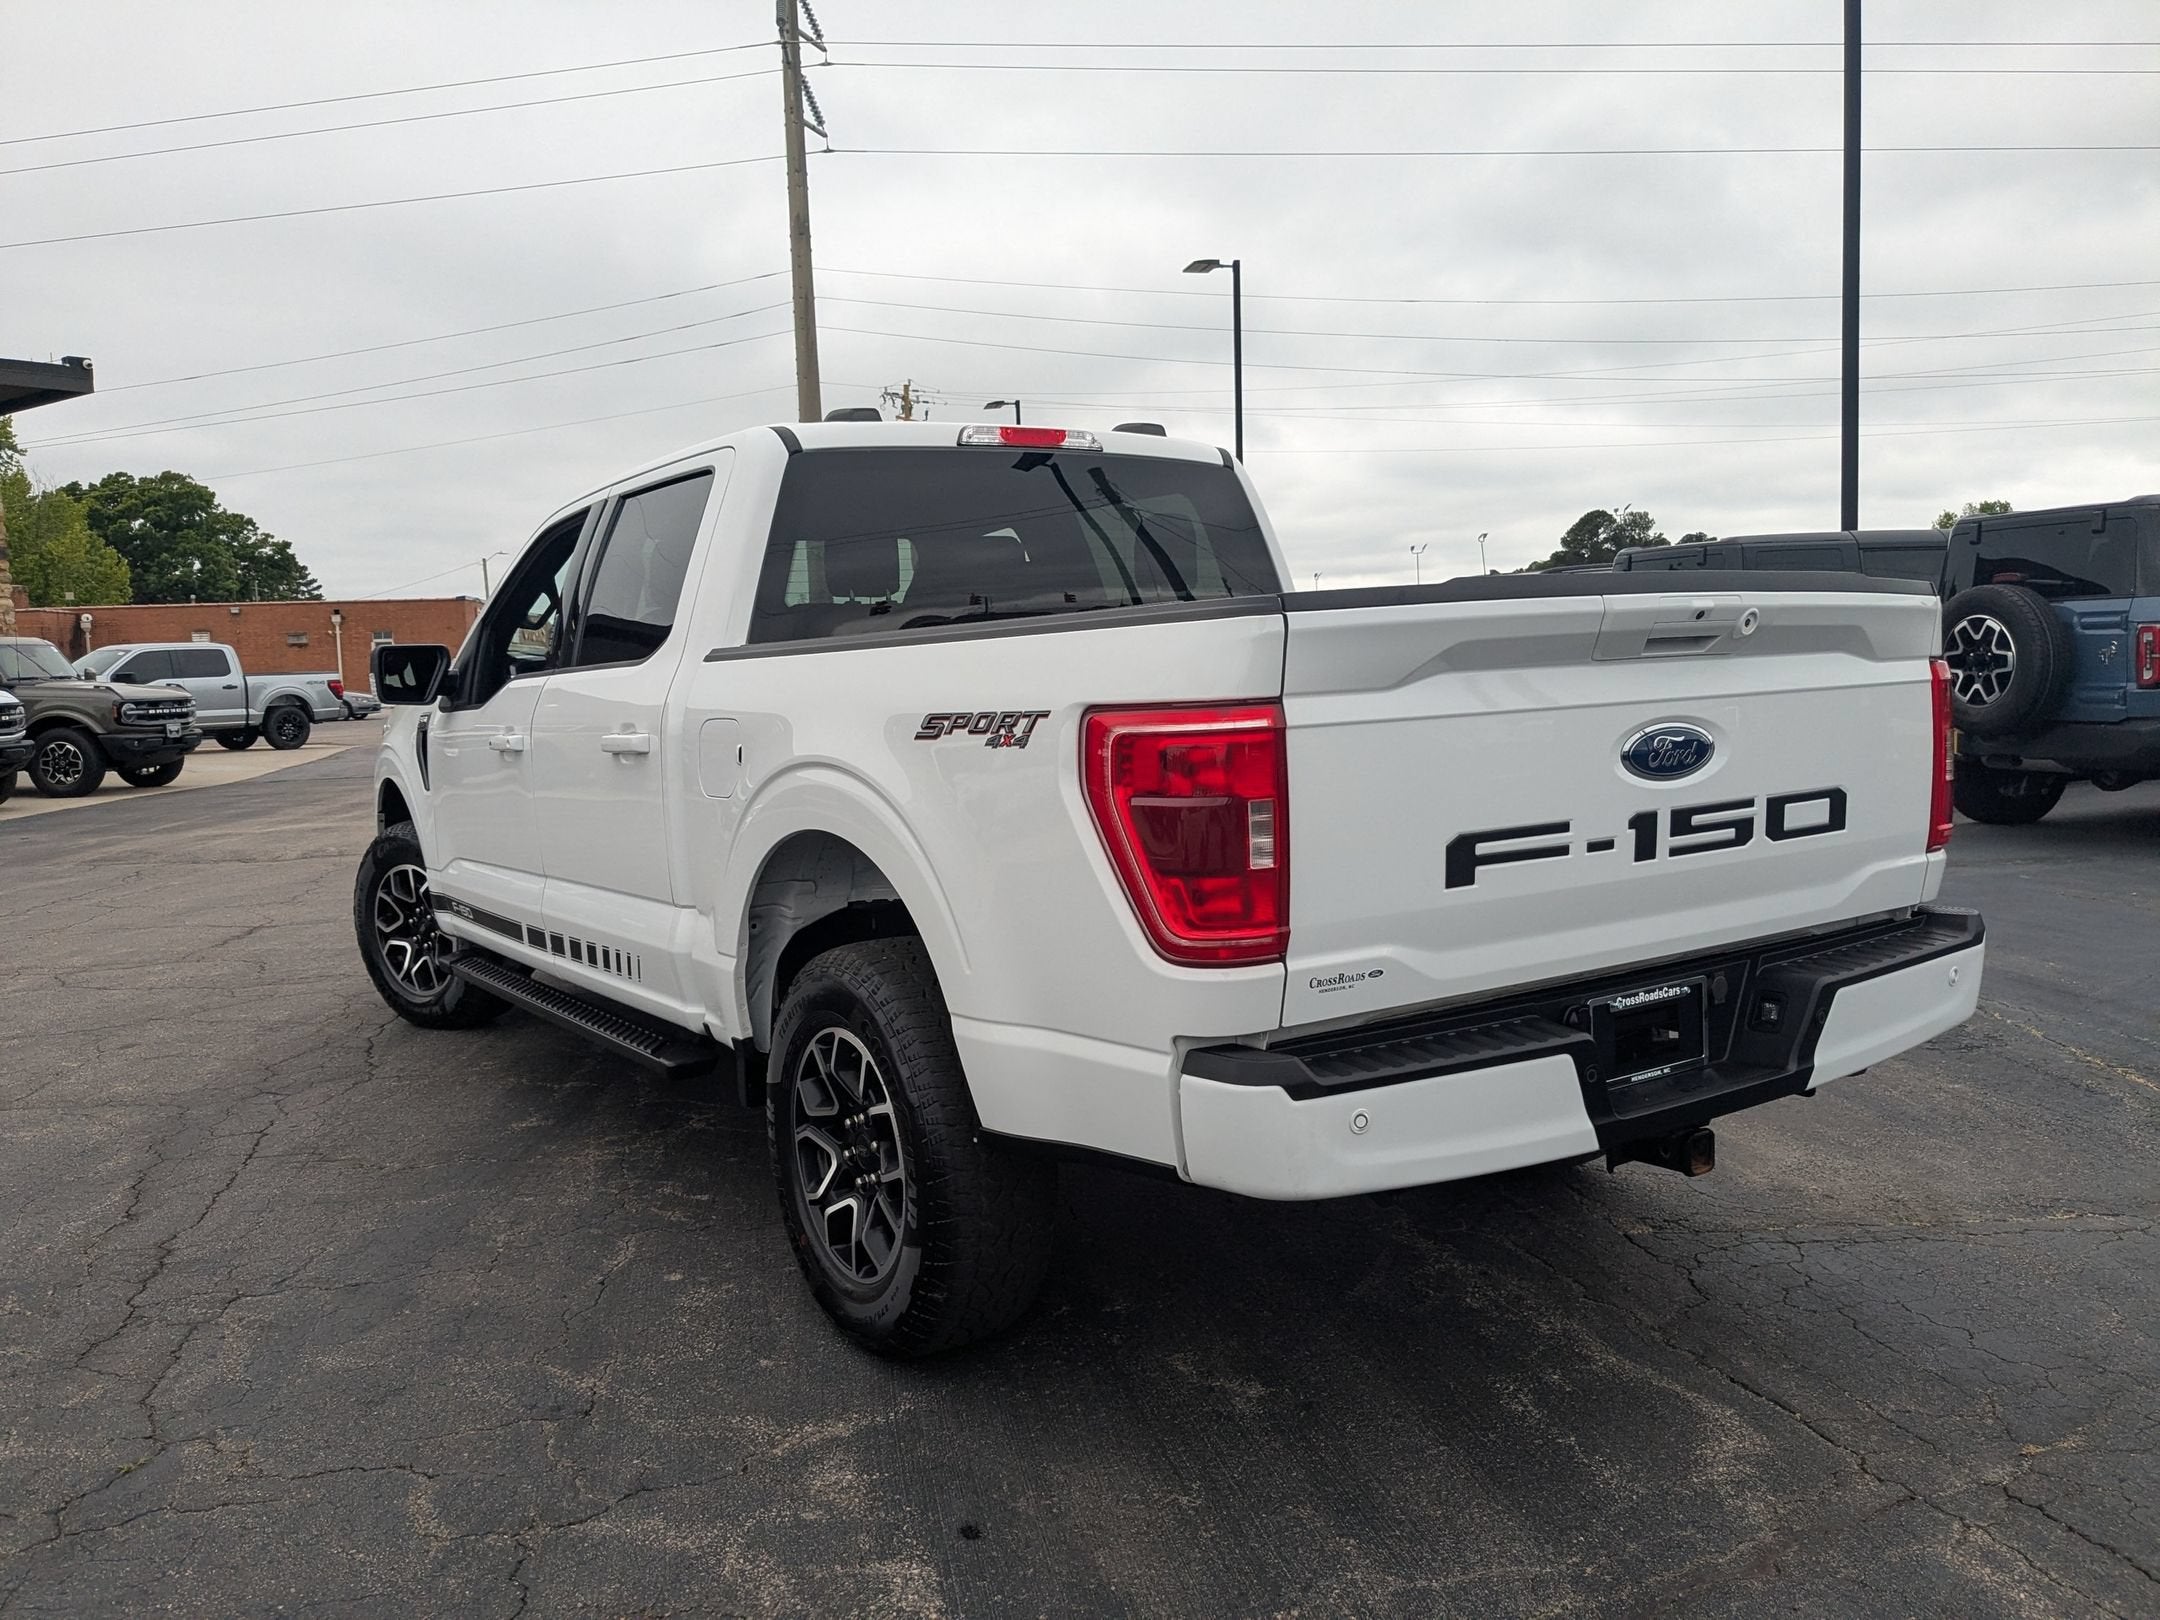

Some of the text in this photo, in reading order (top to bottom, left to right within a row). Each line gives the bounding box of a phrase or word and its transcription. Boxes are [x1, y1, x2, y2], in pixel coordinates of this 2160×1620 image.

[914, 710, 1052, 741] SPORT
[984, 734, 1031, 749] 4x4
[1648, 735, 1698, 768] Ford
[1445, 786, 1848, 890] F-150
[1616, 986, 1681, 1009] CrossRoadsCars
